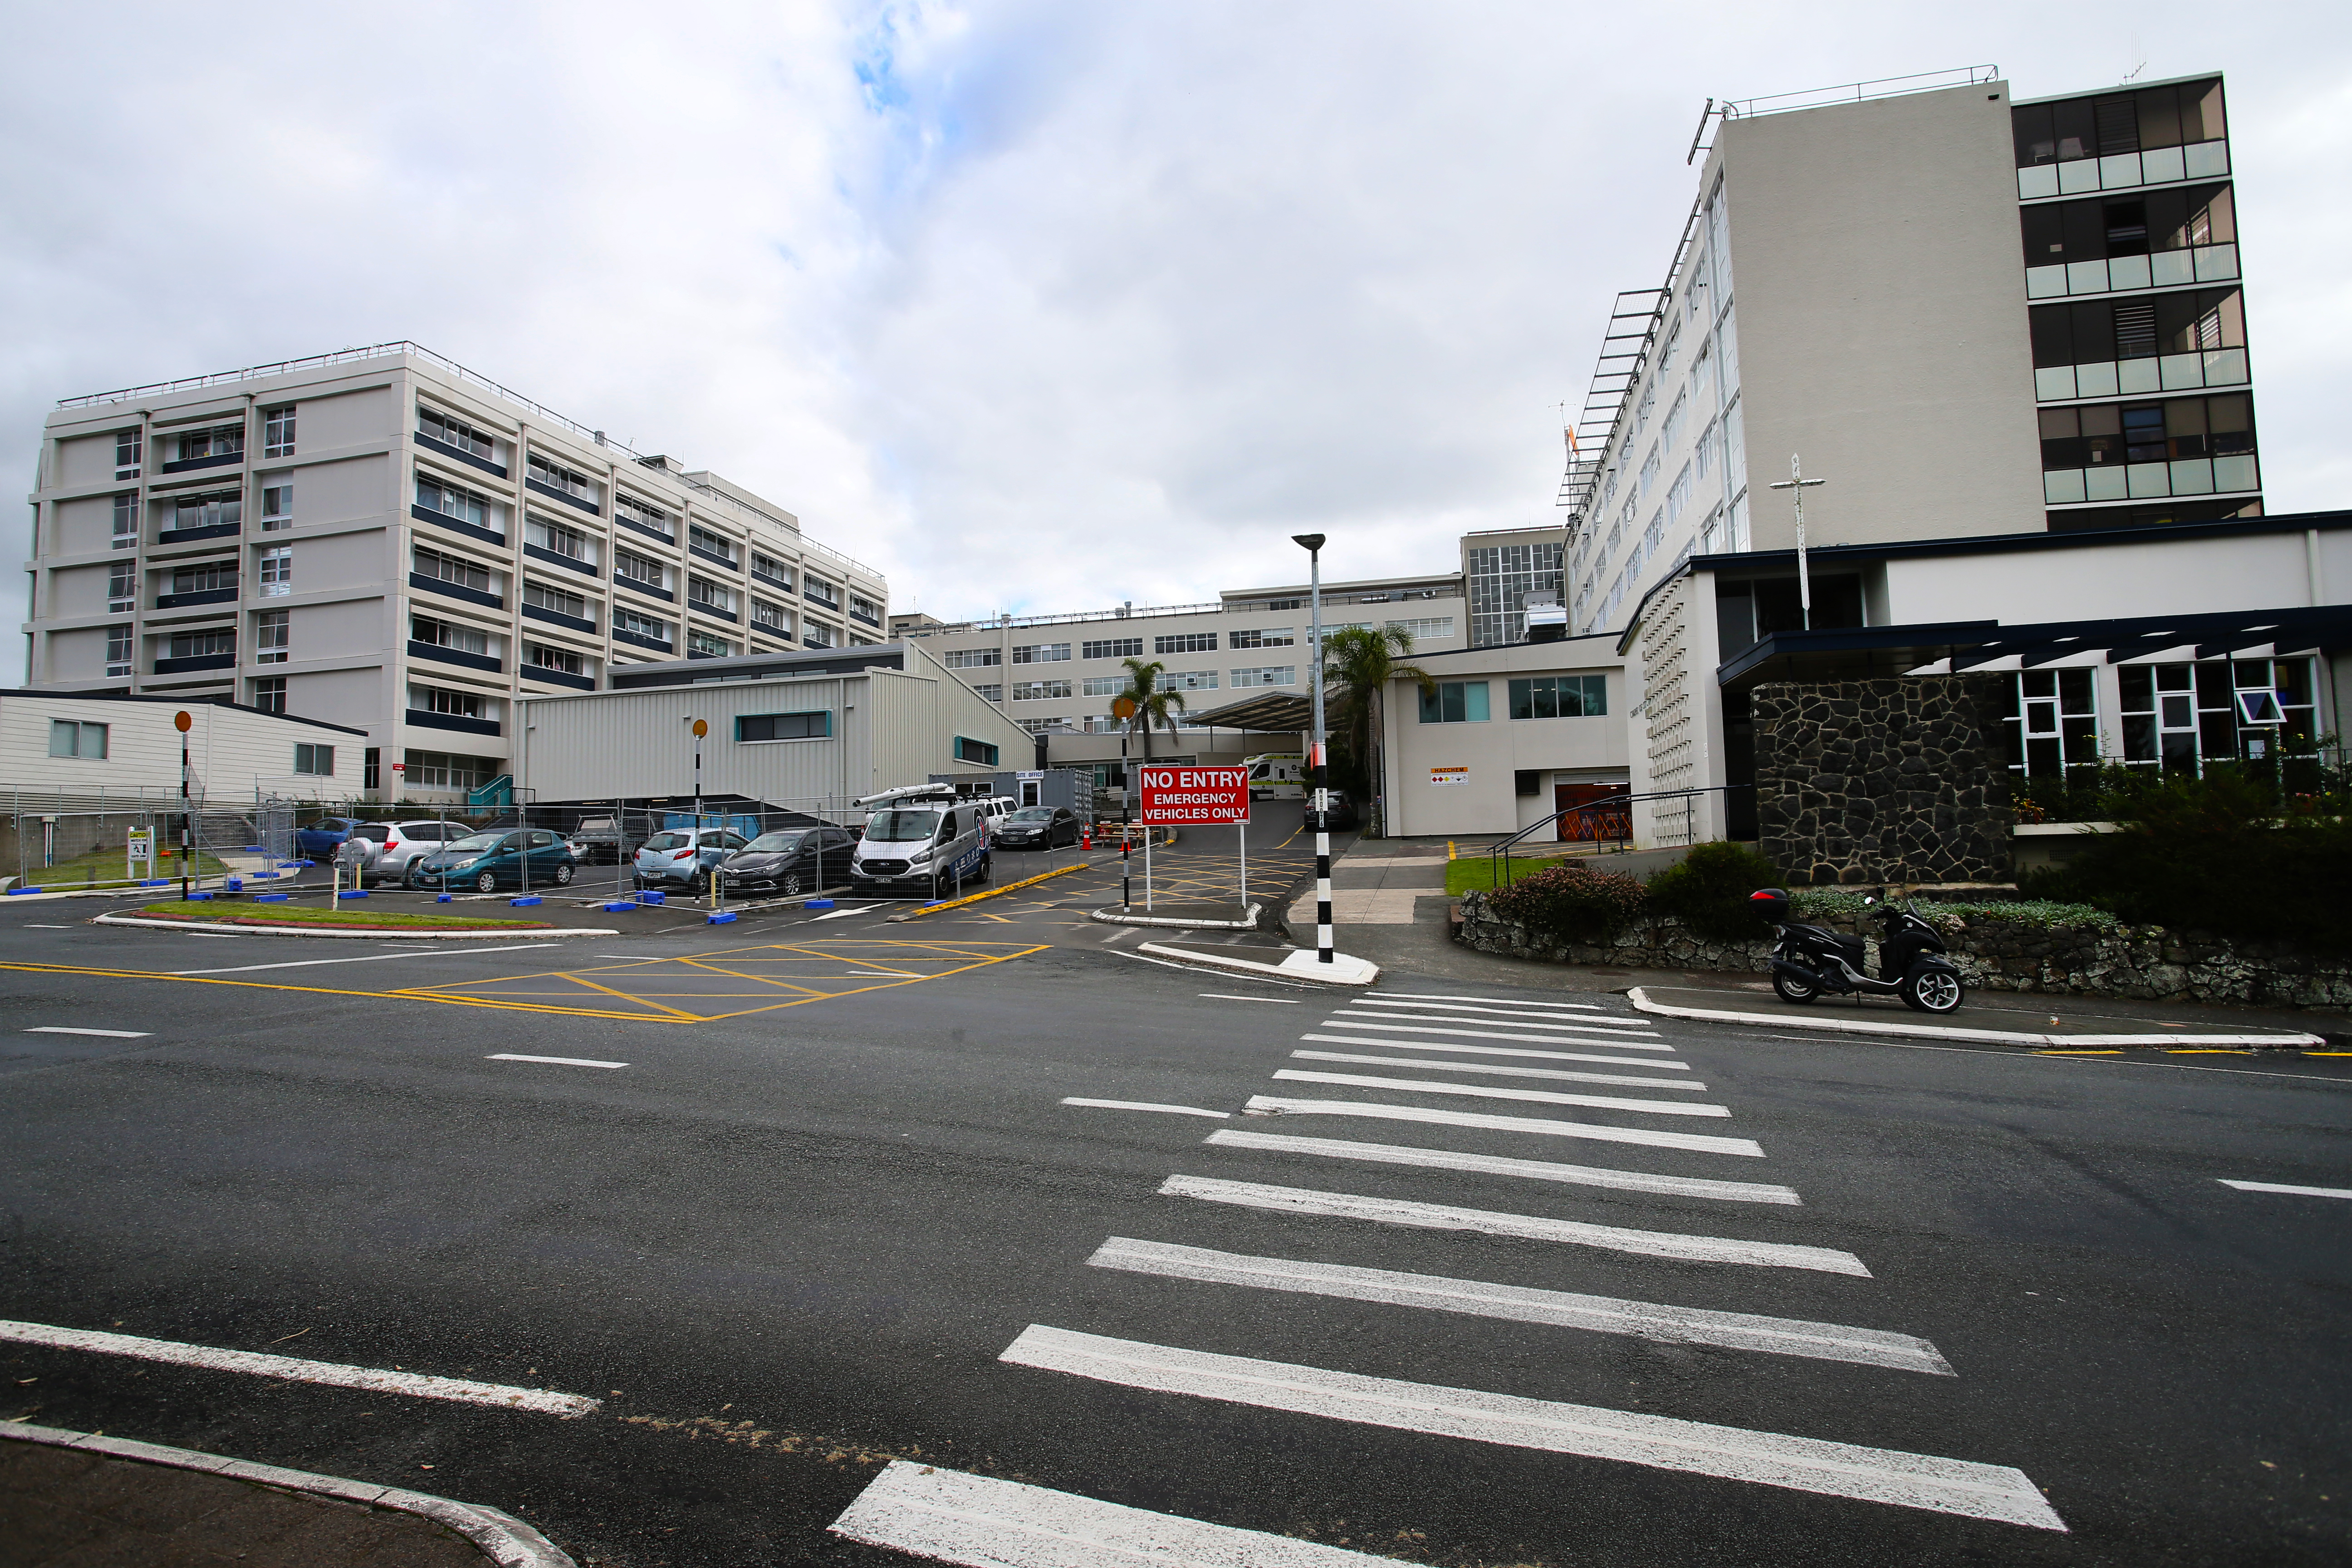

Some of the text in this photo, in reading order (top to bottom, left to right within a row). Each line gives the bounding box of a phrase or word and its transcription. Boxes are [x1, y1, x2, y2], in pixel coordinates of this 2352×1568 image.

[1144, 771, 1246, 788] NO ENTRY
[1154, 793, 1236, 804] EMERGENCY
[1145, 808, 1245, 819] VEHICLES ONLY
